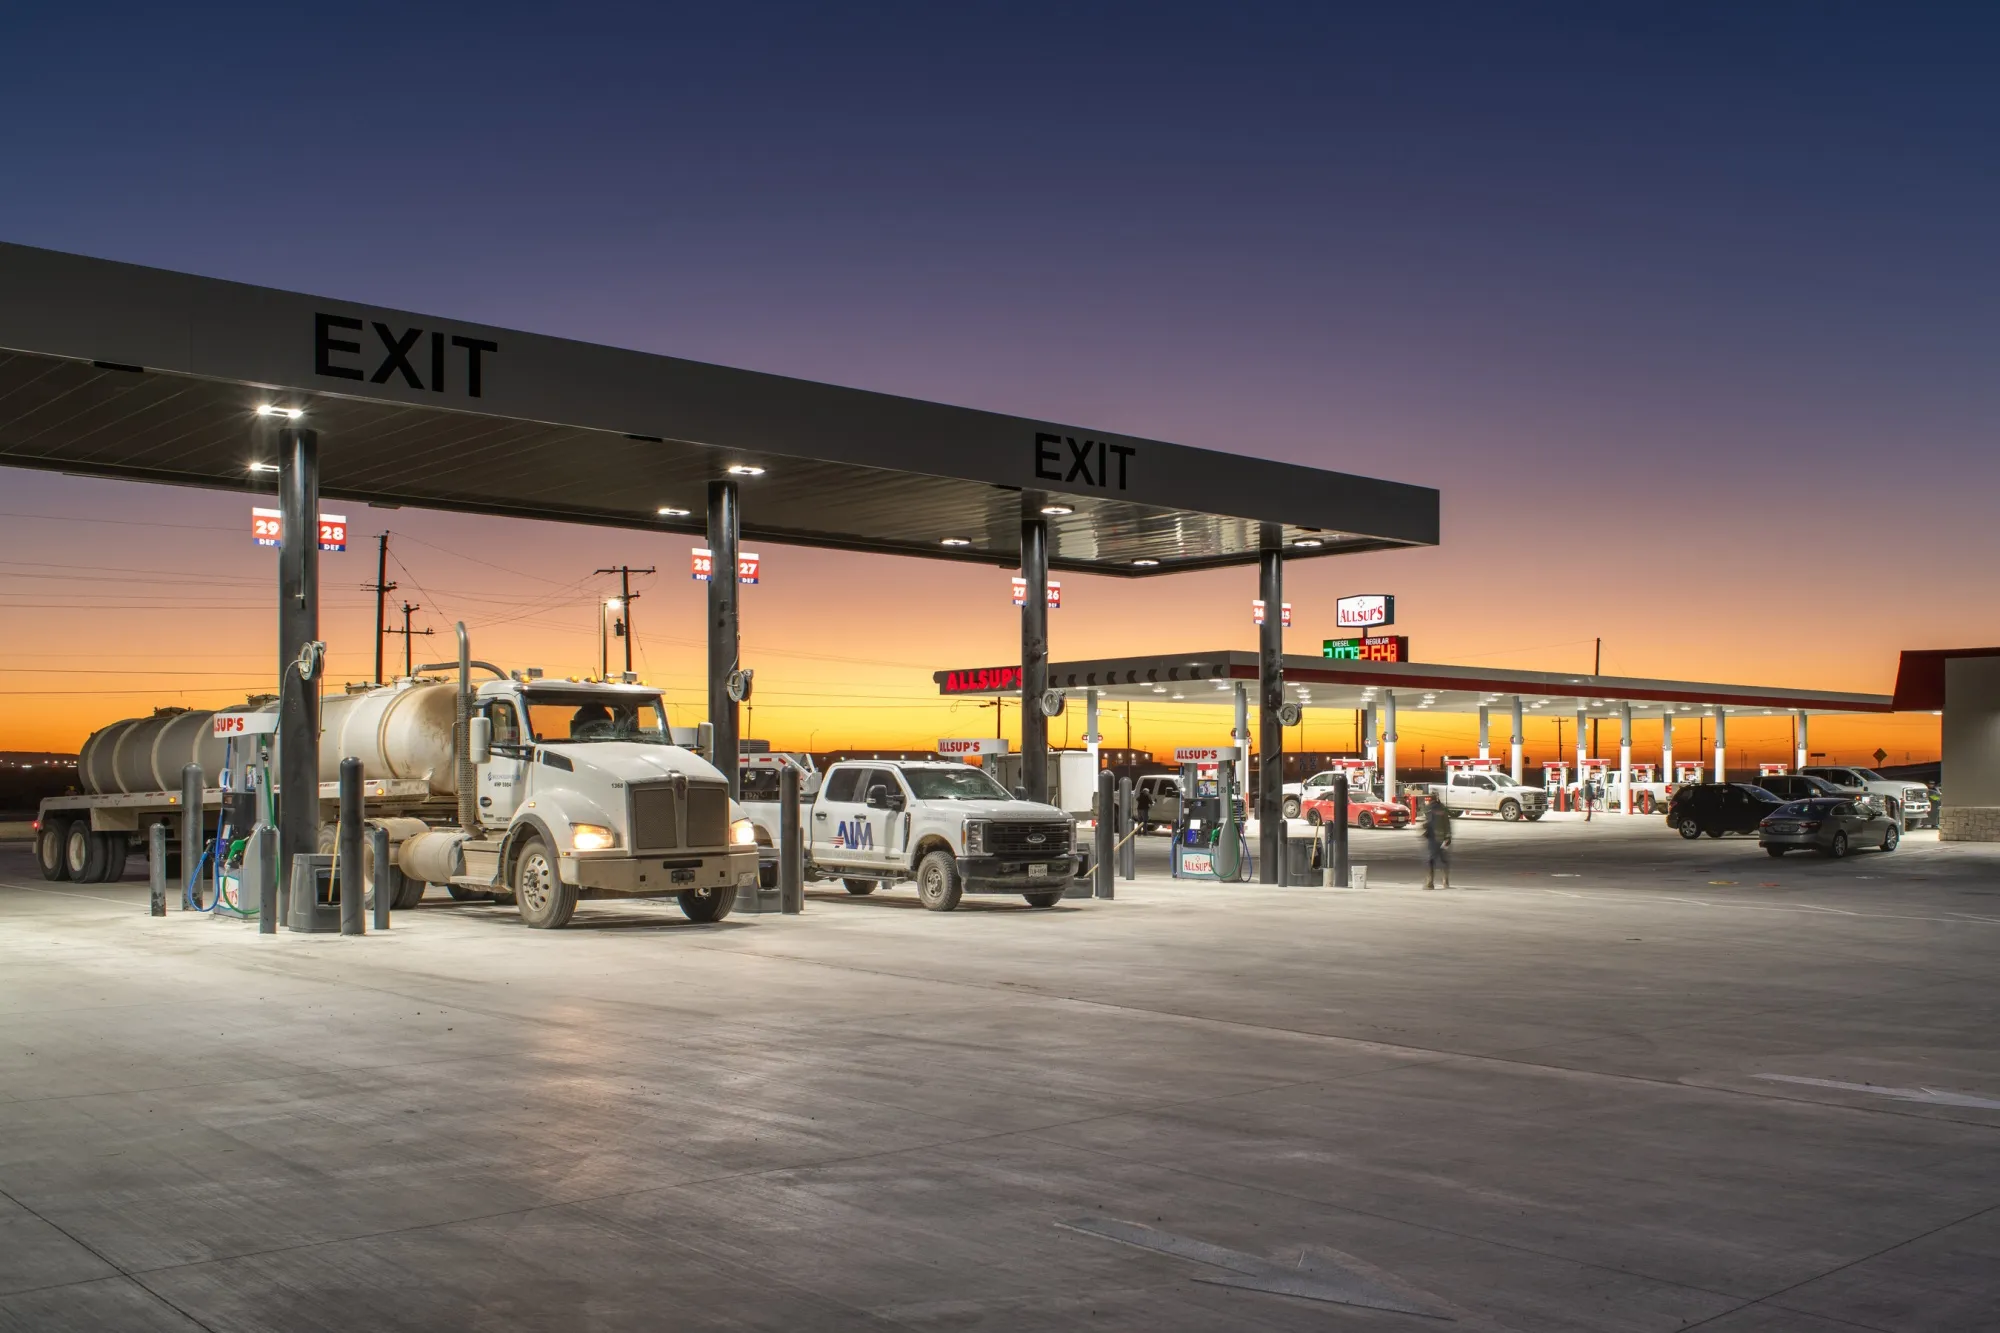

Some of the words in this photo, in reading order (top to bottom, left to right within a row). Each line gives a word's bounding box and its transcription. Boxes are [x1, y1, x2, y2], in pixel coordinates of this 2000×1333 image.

[315, 312, 498, 398] EXIT
[1035, 432, 1136, 490] EXIT
[255, 520, 279, 535] 29
[320, 526, 344, 540] 28
[694, 558, 711, 571] 28
[740, 562, 757, 575] 27
[1013, 586, 1026, 597] 27
[1047, 590, 1059, 600] 26
[1340, 605, 1384, 623] ALLSUP'S
[1365, 638, 1389, 646] REGULAR
[1176, 750, 1217, 759] ALLSUP'S
[1184, 859, 1212, 873] ALLSUP'S
